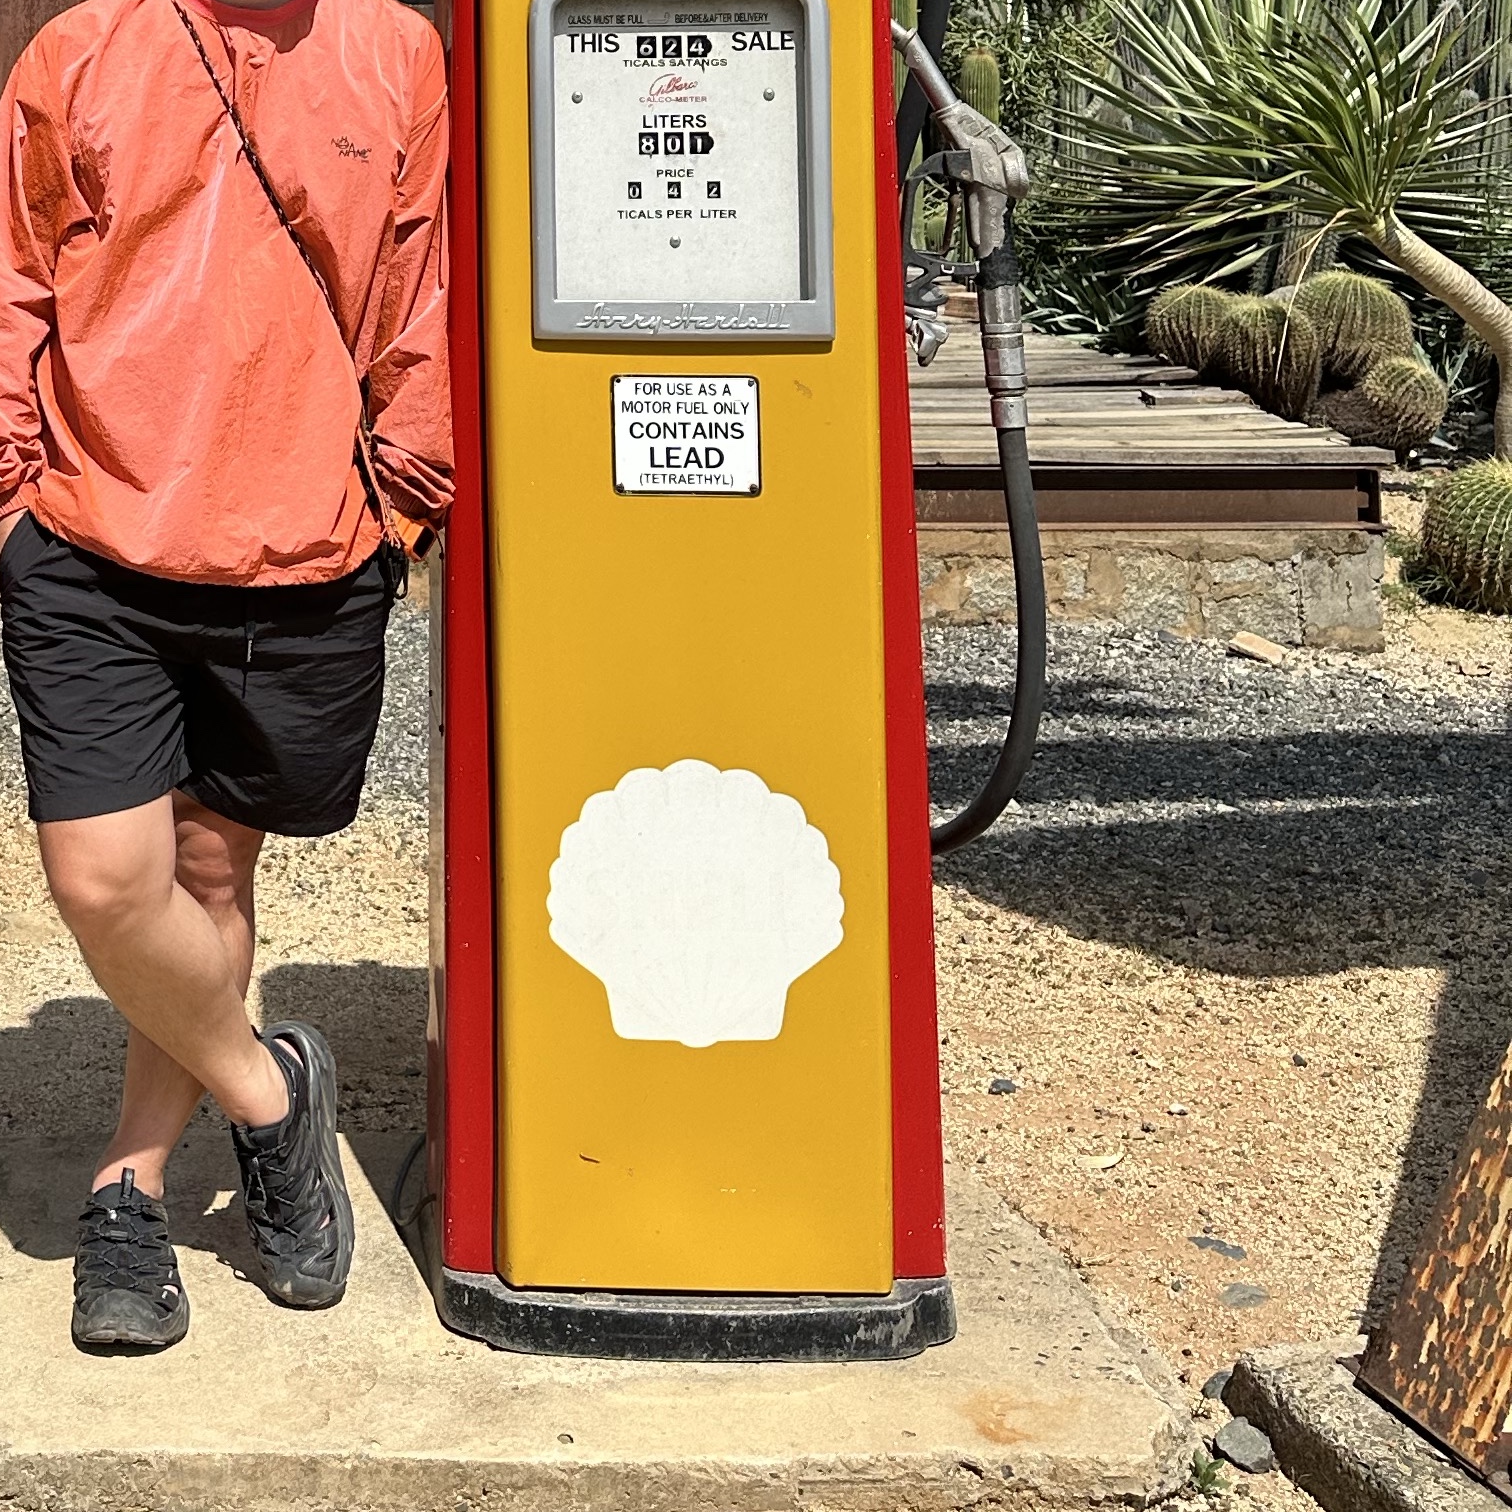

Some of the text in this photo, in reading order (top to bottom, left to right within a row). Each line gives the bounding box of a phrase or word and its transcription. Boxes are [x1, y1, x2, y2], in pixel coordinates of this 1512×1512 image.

[594, 15, 613, 24] MUST
[616, 15, 626, 23] BE
[627, 14, 644, 24] FULL
[734, 13, 769, 23] DELIVERY
[567, 33, 620, 53] THIS
[731, 30, 795, 52] SALE
[623, 59, 728, 67] TICALS SATANGS
[643, 115, 706, 128] LITERS
[657, 169, 694, 178] PRICE
[617, 209, 737, 219] TICALS PER LITER
[635, 383, 731, 396] FOR USE AS A
[621, 401, 749, 415] MOTOR FUEL ONLY
[629, 422, 745, 439] CONTAINS
[650, 447, 725, 469] LEAD
[639, 473, 734, 487] (TETRAETHYL)
